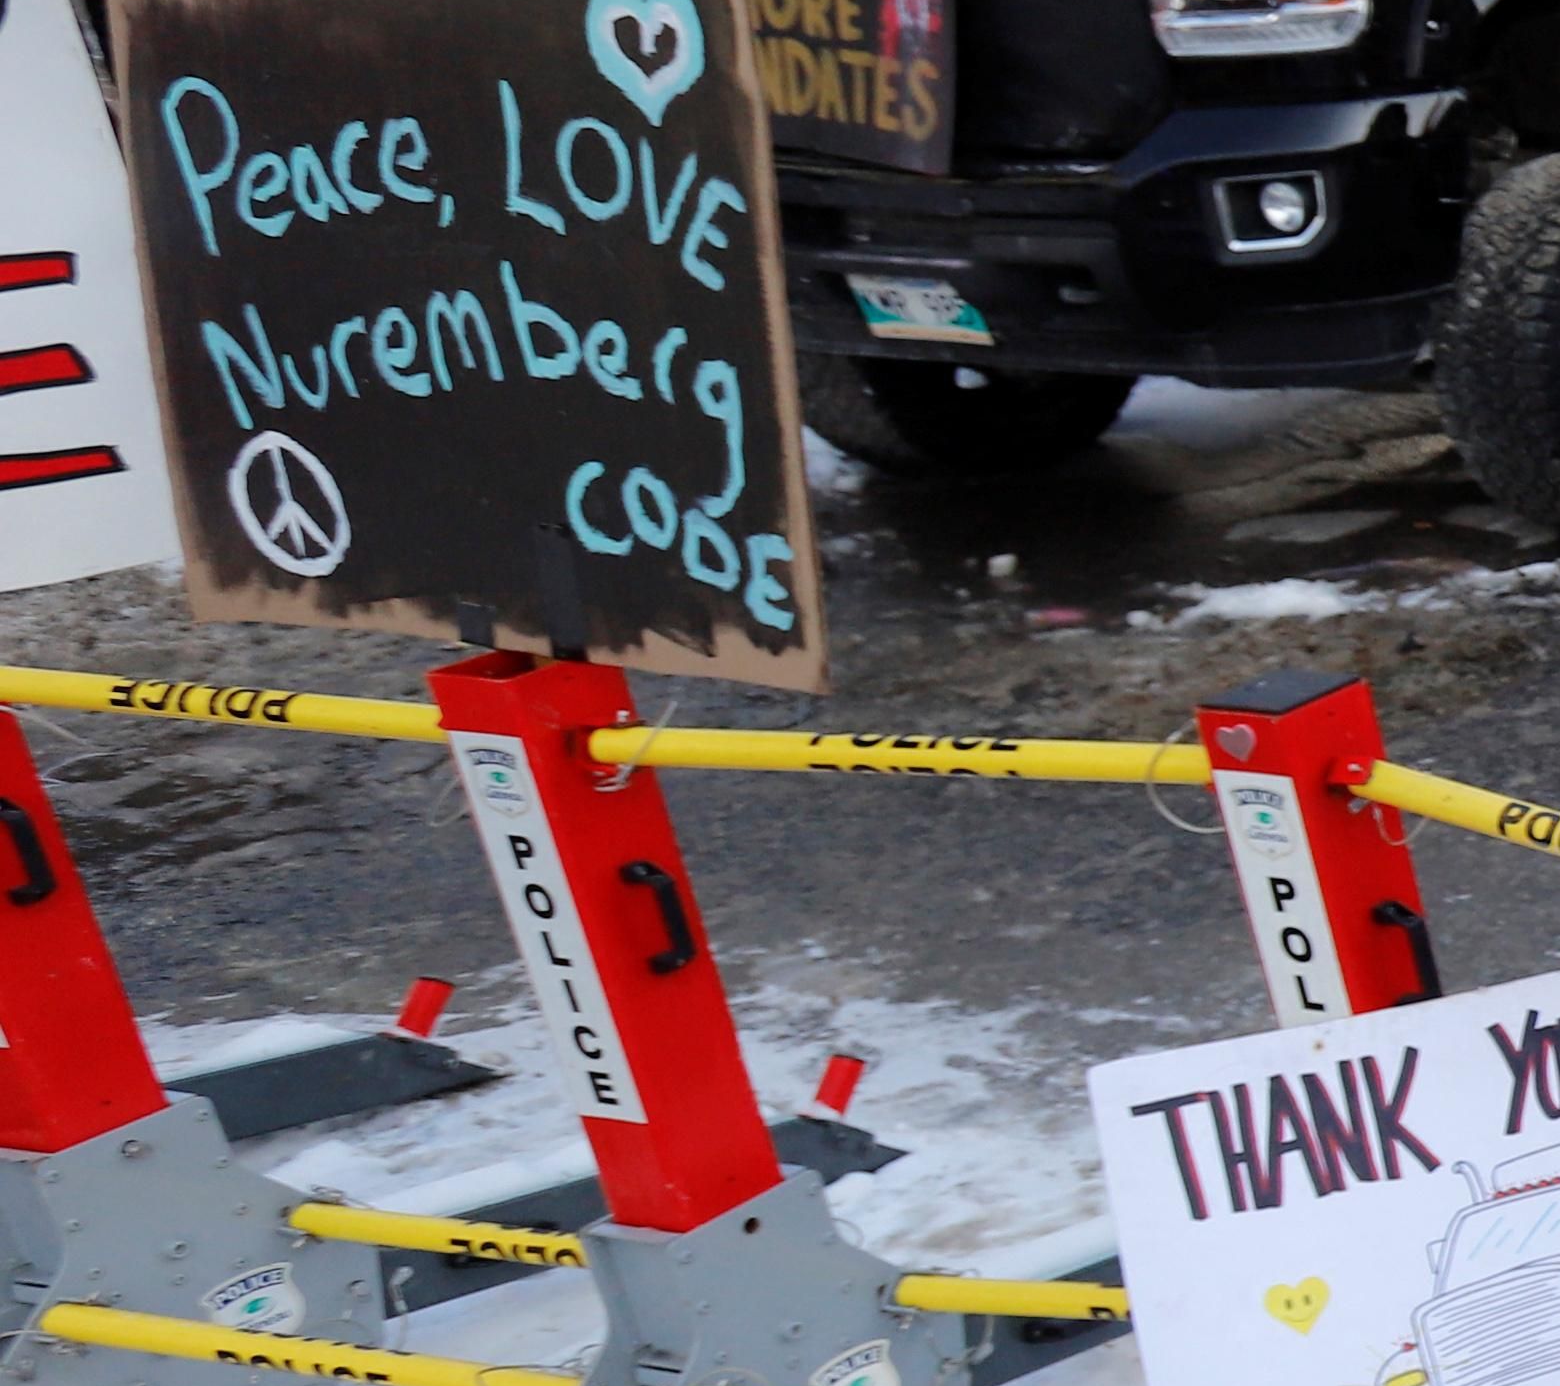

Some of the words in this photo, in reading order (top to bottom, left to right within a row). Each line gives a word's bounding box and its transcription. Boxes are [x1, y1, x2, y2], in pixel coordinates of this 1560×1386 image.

[753, 35, 943, 143] NDATES
[160, 76, 458, 257] Peace,
[498, 78, 748, 293] LOVE
[201, 259, 745, 522] Nuremberg
[565, 459, 797, 633] CODE
[507, 833, 621, 1107] POLICE
[1130, 1046, 1442, 1221] THANK
[211, 1267, 286, 1310] POLICE
